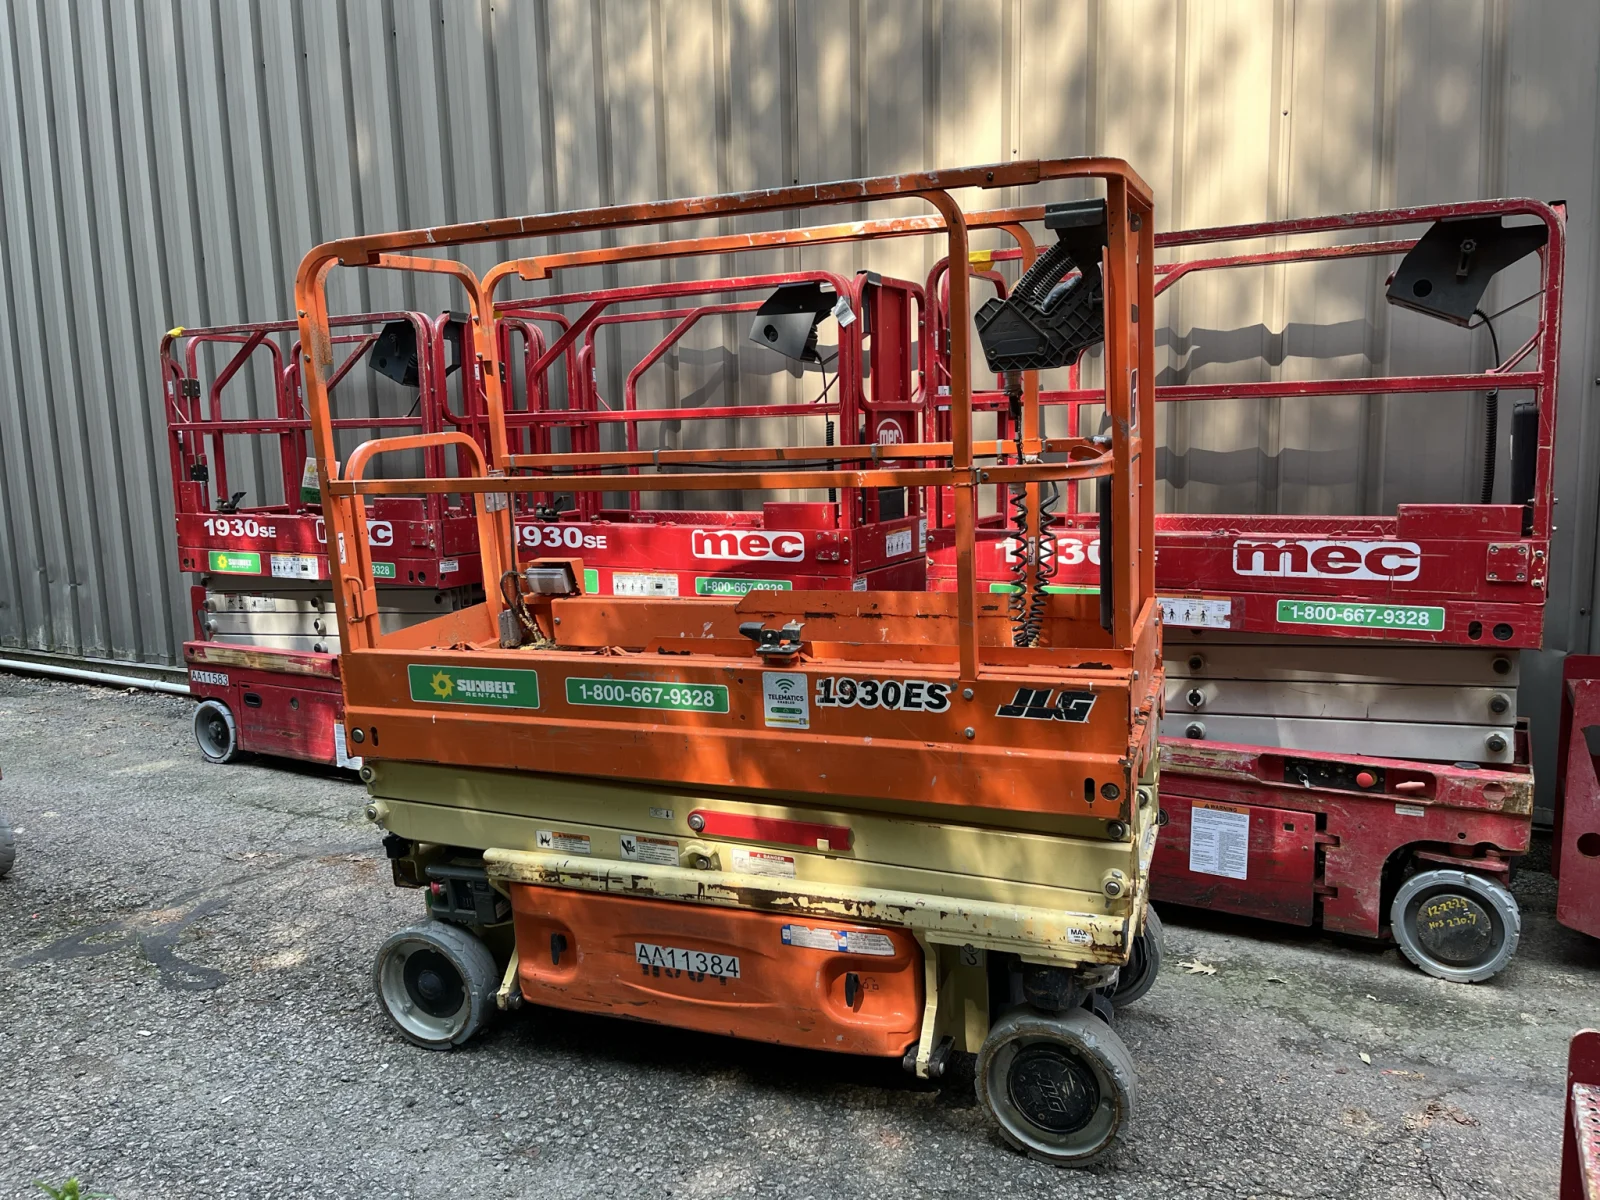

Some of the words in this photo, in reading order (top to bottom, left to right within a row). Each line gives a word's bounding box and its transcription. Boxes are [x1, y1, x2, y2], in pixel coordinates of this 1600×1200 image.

[203, 518, 277, 538] 1930SE
[693, 531, 804, 558] mec
[1236, 542, 1419, 577] mec
[1290, 605, 1430, 626] 1-800-667-9328
[191, 670, 228, 686] AA11583
[456, 679, 516, 694] SUNBELT
[578, 683, 715, 707] 1-800-667-9328
[767, 693, 804, 702] TELEMATICS
[817, 677, 951, 712] 1930ES
[994, 687, 1097, 723] JLG
[1211, 804, 1238, 813] WARNING
[1070, 928, 1088, 936] MAX
[637, 944, 739, 978] AA11384
